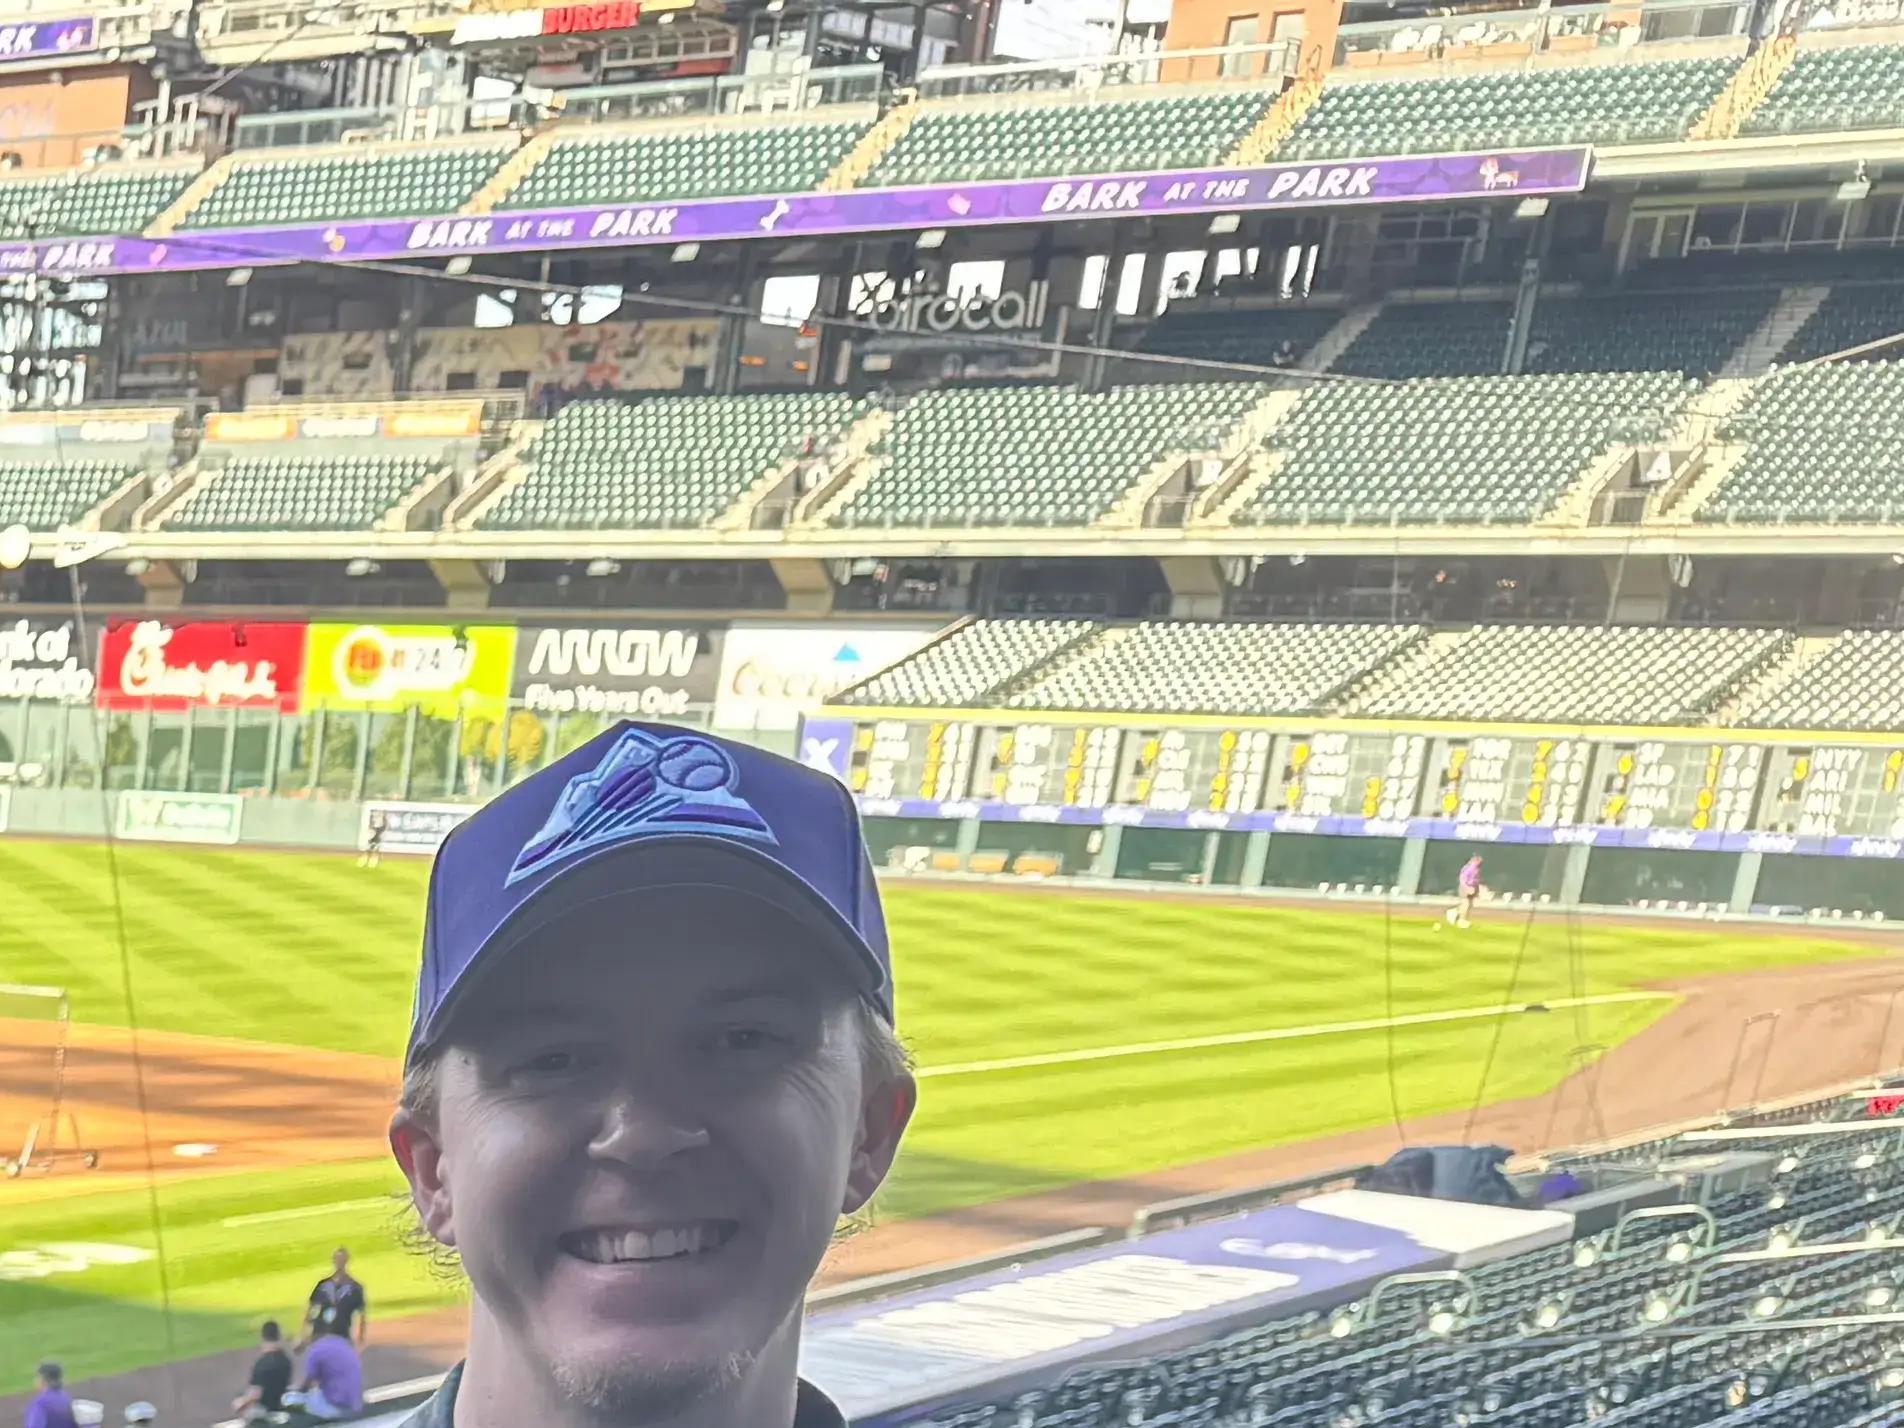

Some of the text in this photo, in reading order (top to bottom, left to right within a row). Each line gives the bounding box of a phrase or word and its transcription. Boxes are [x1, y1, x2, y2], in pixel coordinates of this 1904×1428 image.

[1042, 167, 1380, 212] BARK AT THE PARK
[407, 219, 493, 248] BARK
[589, 208, 680, 237] PARK
[40, 243, 116, 269] PARK
[640, 686, 691, 714] Out
